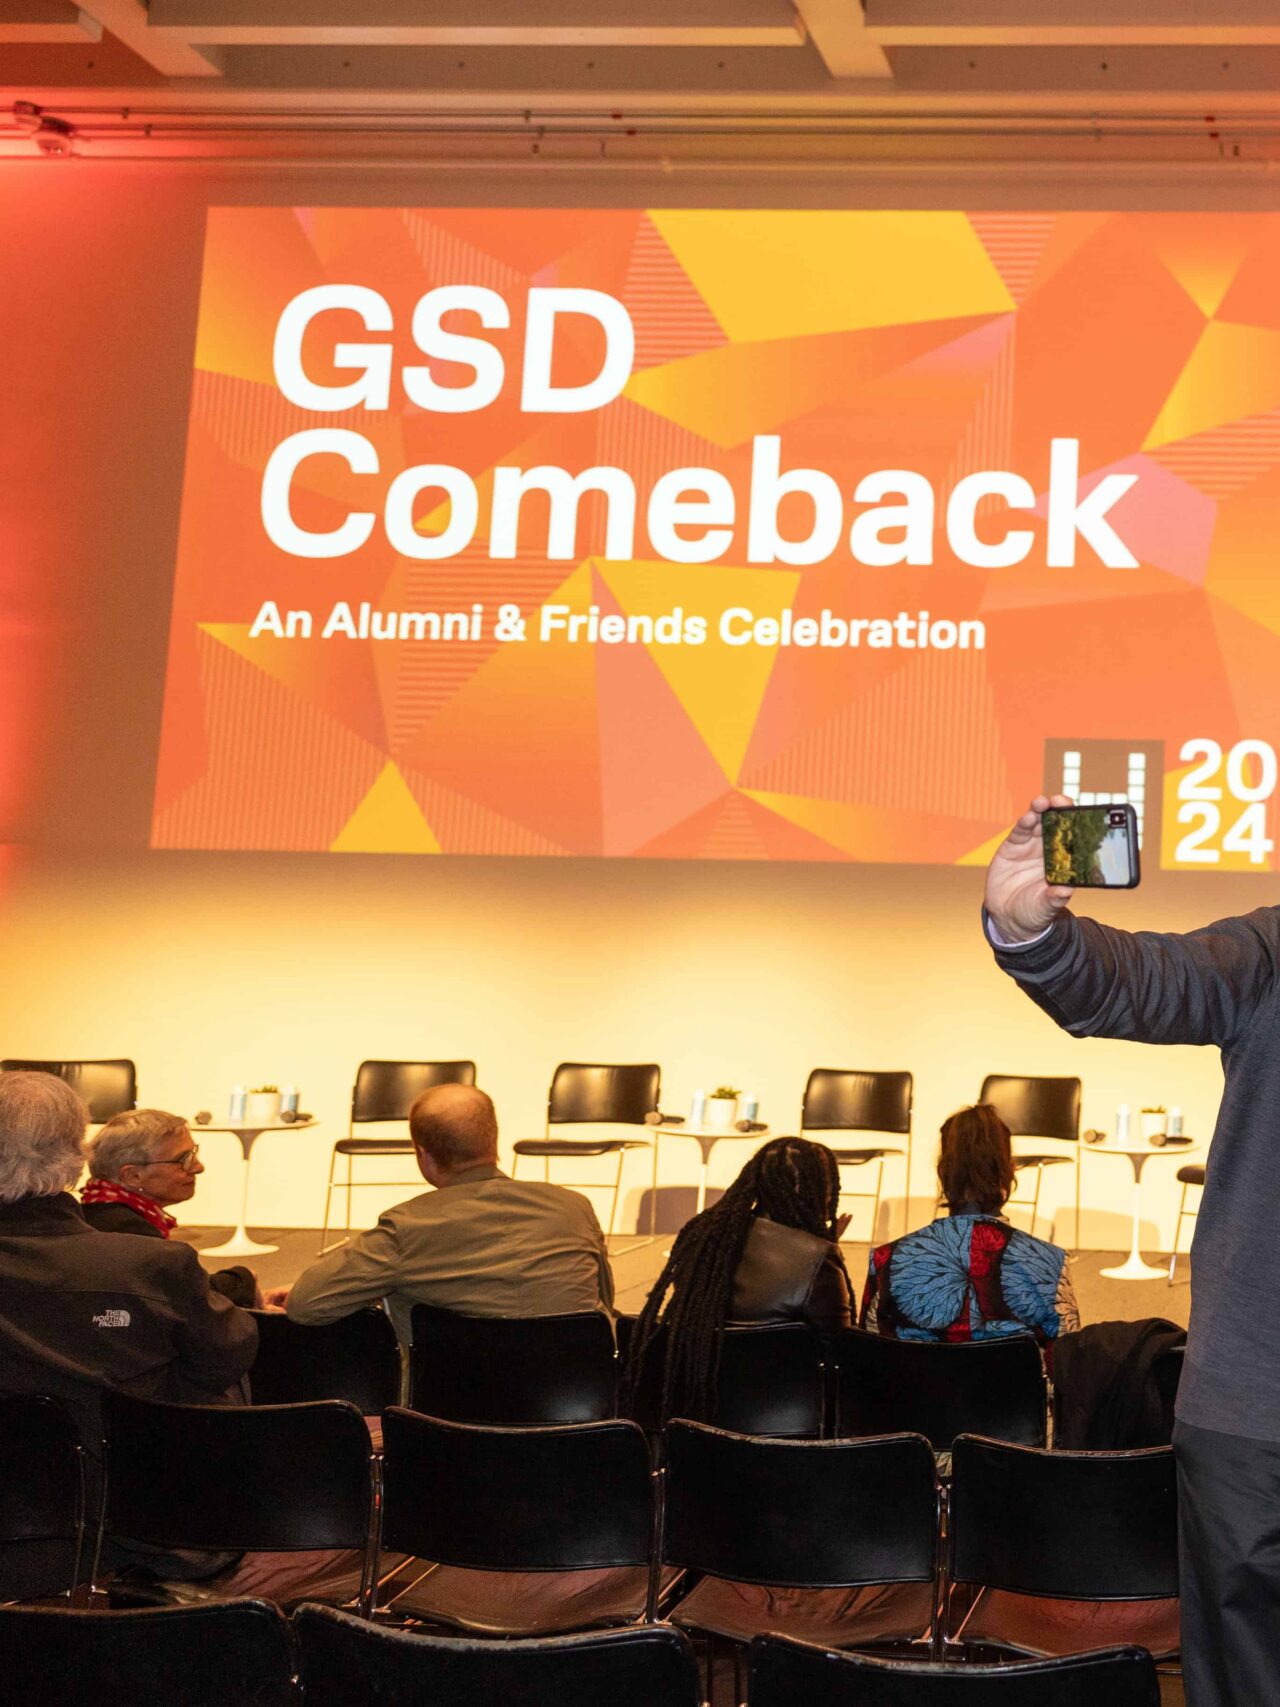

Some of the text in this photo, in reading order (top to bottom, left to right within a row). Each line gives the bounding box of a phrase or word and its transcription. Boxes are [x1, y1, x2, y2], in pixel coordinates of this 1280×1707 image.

[273, 284, 635, 413] GSD
[261, 428, 1140, 569] Comeback
[249, 601, 986, 650] An Alumni & Friends Celebration
[1177, 738, 1277, 802] 20
[1175, 801, 1274, 863] 24
